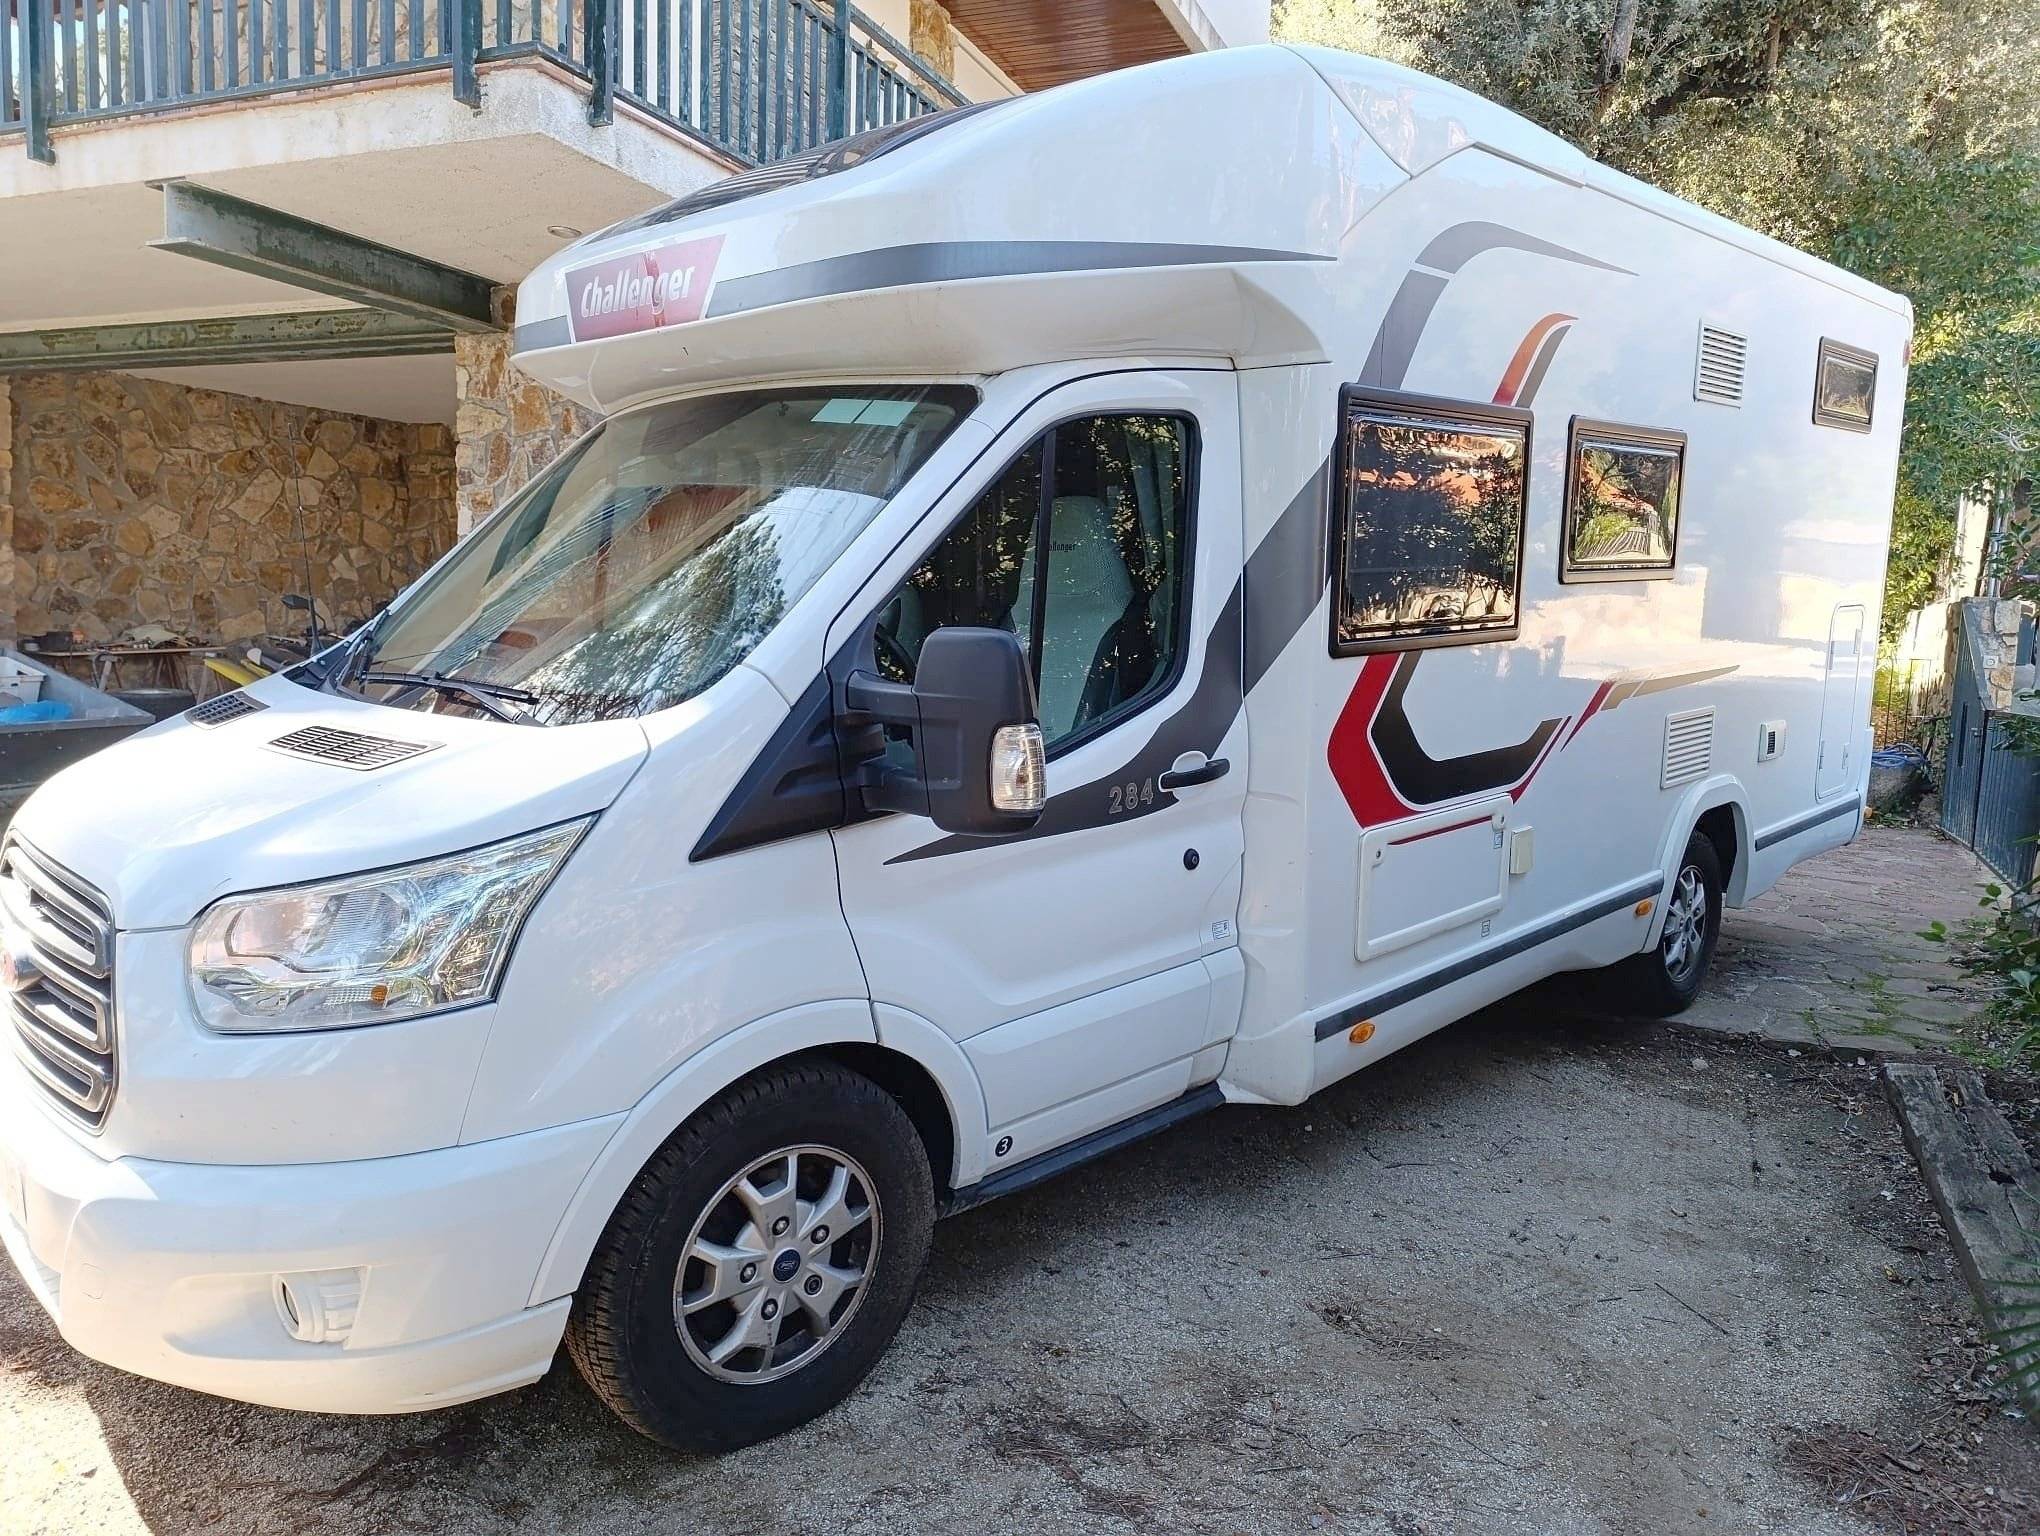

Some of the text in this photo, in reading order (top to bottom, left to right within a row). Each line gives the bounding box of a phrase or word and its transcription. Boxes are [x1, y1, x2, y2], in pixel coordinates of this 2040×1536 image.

[580, 265, 695, 318] Challenger
[1109, 777, 1153, 815] 284
[998, 1138, 1009, 1154] 3
